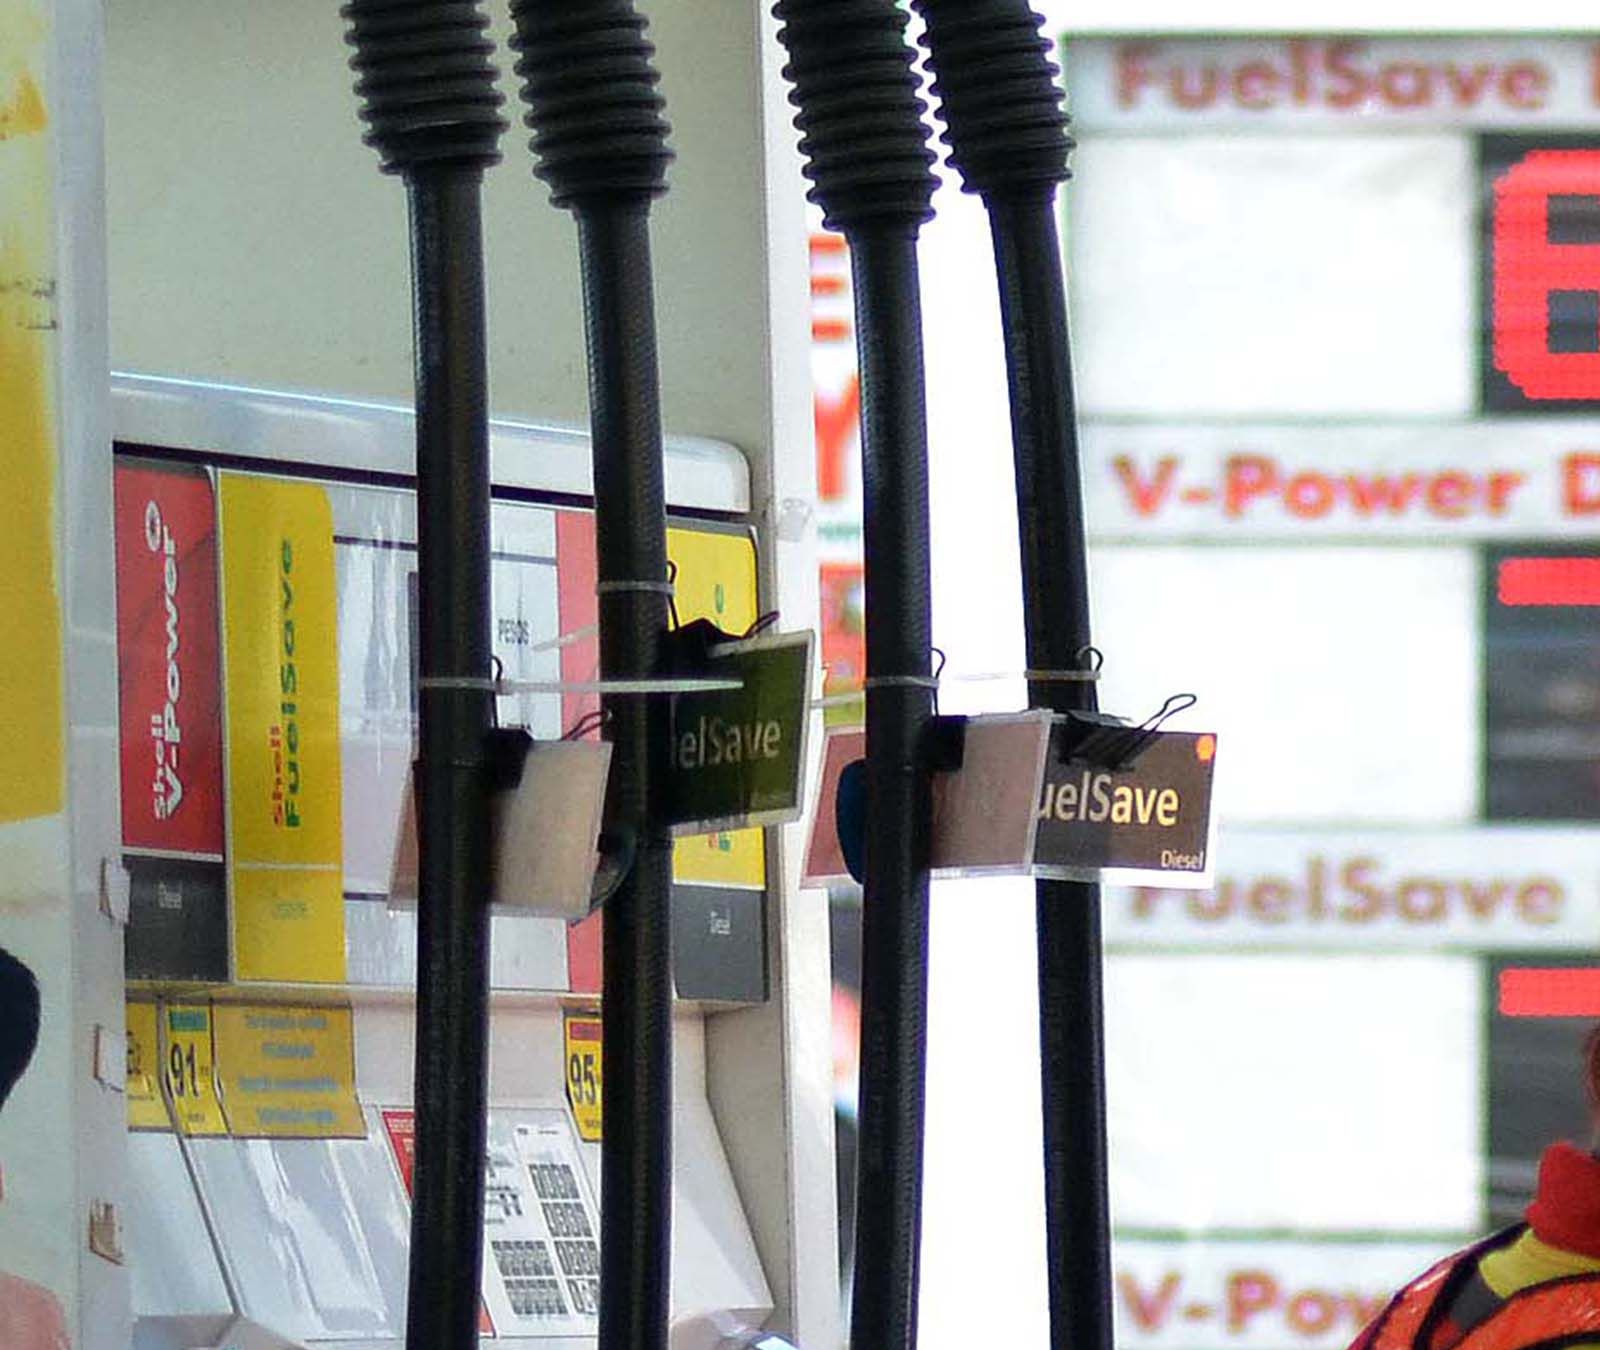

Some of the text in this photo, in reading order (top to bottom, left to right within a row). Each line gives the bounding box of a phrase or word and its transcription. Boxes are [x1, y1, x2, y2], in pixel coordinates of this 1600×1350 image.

[1111, 38, 1550, 111] FuelSave
[1112, 452, 1524, 521] V-Power
[160, 523, 184, 818] V-Power
[280, 538, 301, 829] FuelSave
[674, 714, 783, 770] elSave
[1037, 770, 1180, 827] uelSave
[1160, 850, 1204, 870] Diesel
[170, 1042, 200, 1098] 91
[570, 1052, 598, 1106] 95
